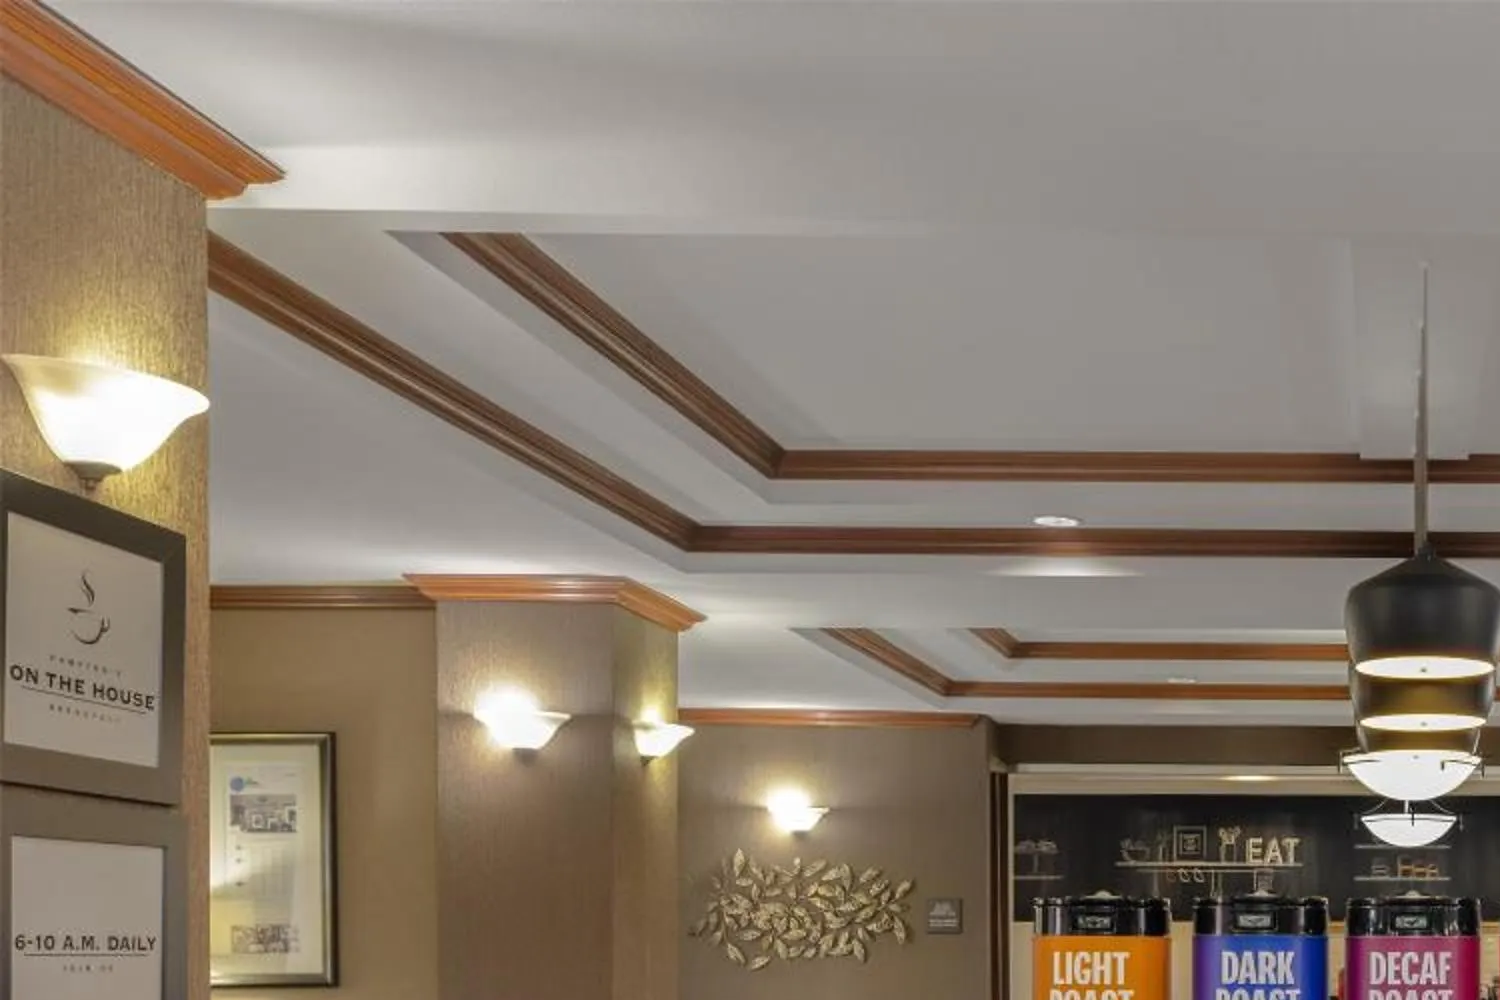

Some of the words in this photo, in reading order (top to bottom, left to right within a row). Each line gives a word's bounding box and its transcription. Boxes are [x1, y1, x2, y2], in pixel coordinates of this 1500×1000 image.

[9, 664, 39, 685] ON
[45, 671, 85, 695] THE
[93, 683, 155, 711] HOUSE
[1246, 836, 1300, 865] EAT
[15, 934, 55, 951] 6-10
[62, 934, 100, 951] A.M.
[107, 935, 156, 951] DAILY
[1053, 951, 1131, 985] LIGHT
[1221, 951, 1295, 985] DARK
[1369, 951, 1453, 985] DECAF
